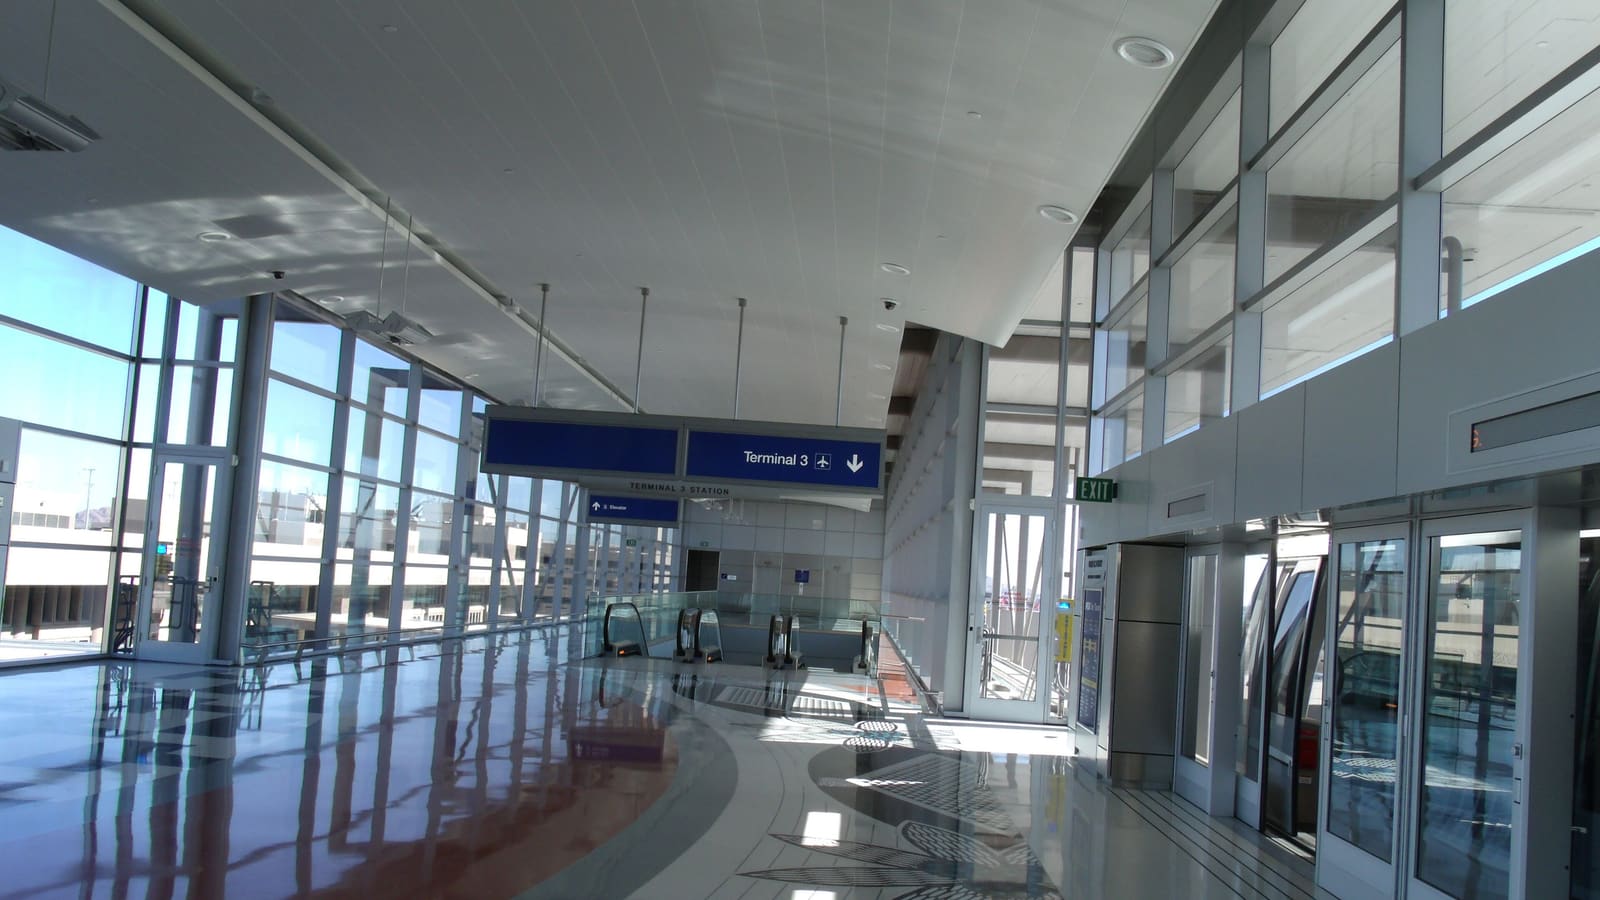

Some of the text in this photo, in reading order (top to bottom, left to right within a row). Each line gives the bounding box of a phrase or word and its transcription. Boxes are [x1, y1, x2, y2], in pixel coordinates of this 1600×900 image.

[743, 450, 809, 467] Terminal 3
[630, 482, 730, 496] TERMINAL 3 STATION
[1081, 480, 1109, 501] EXIT
